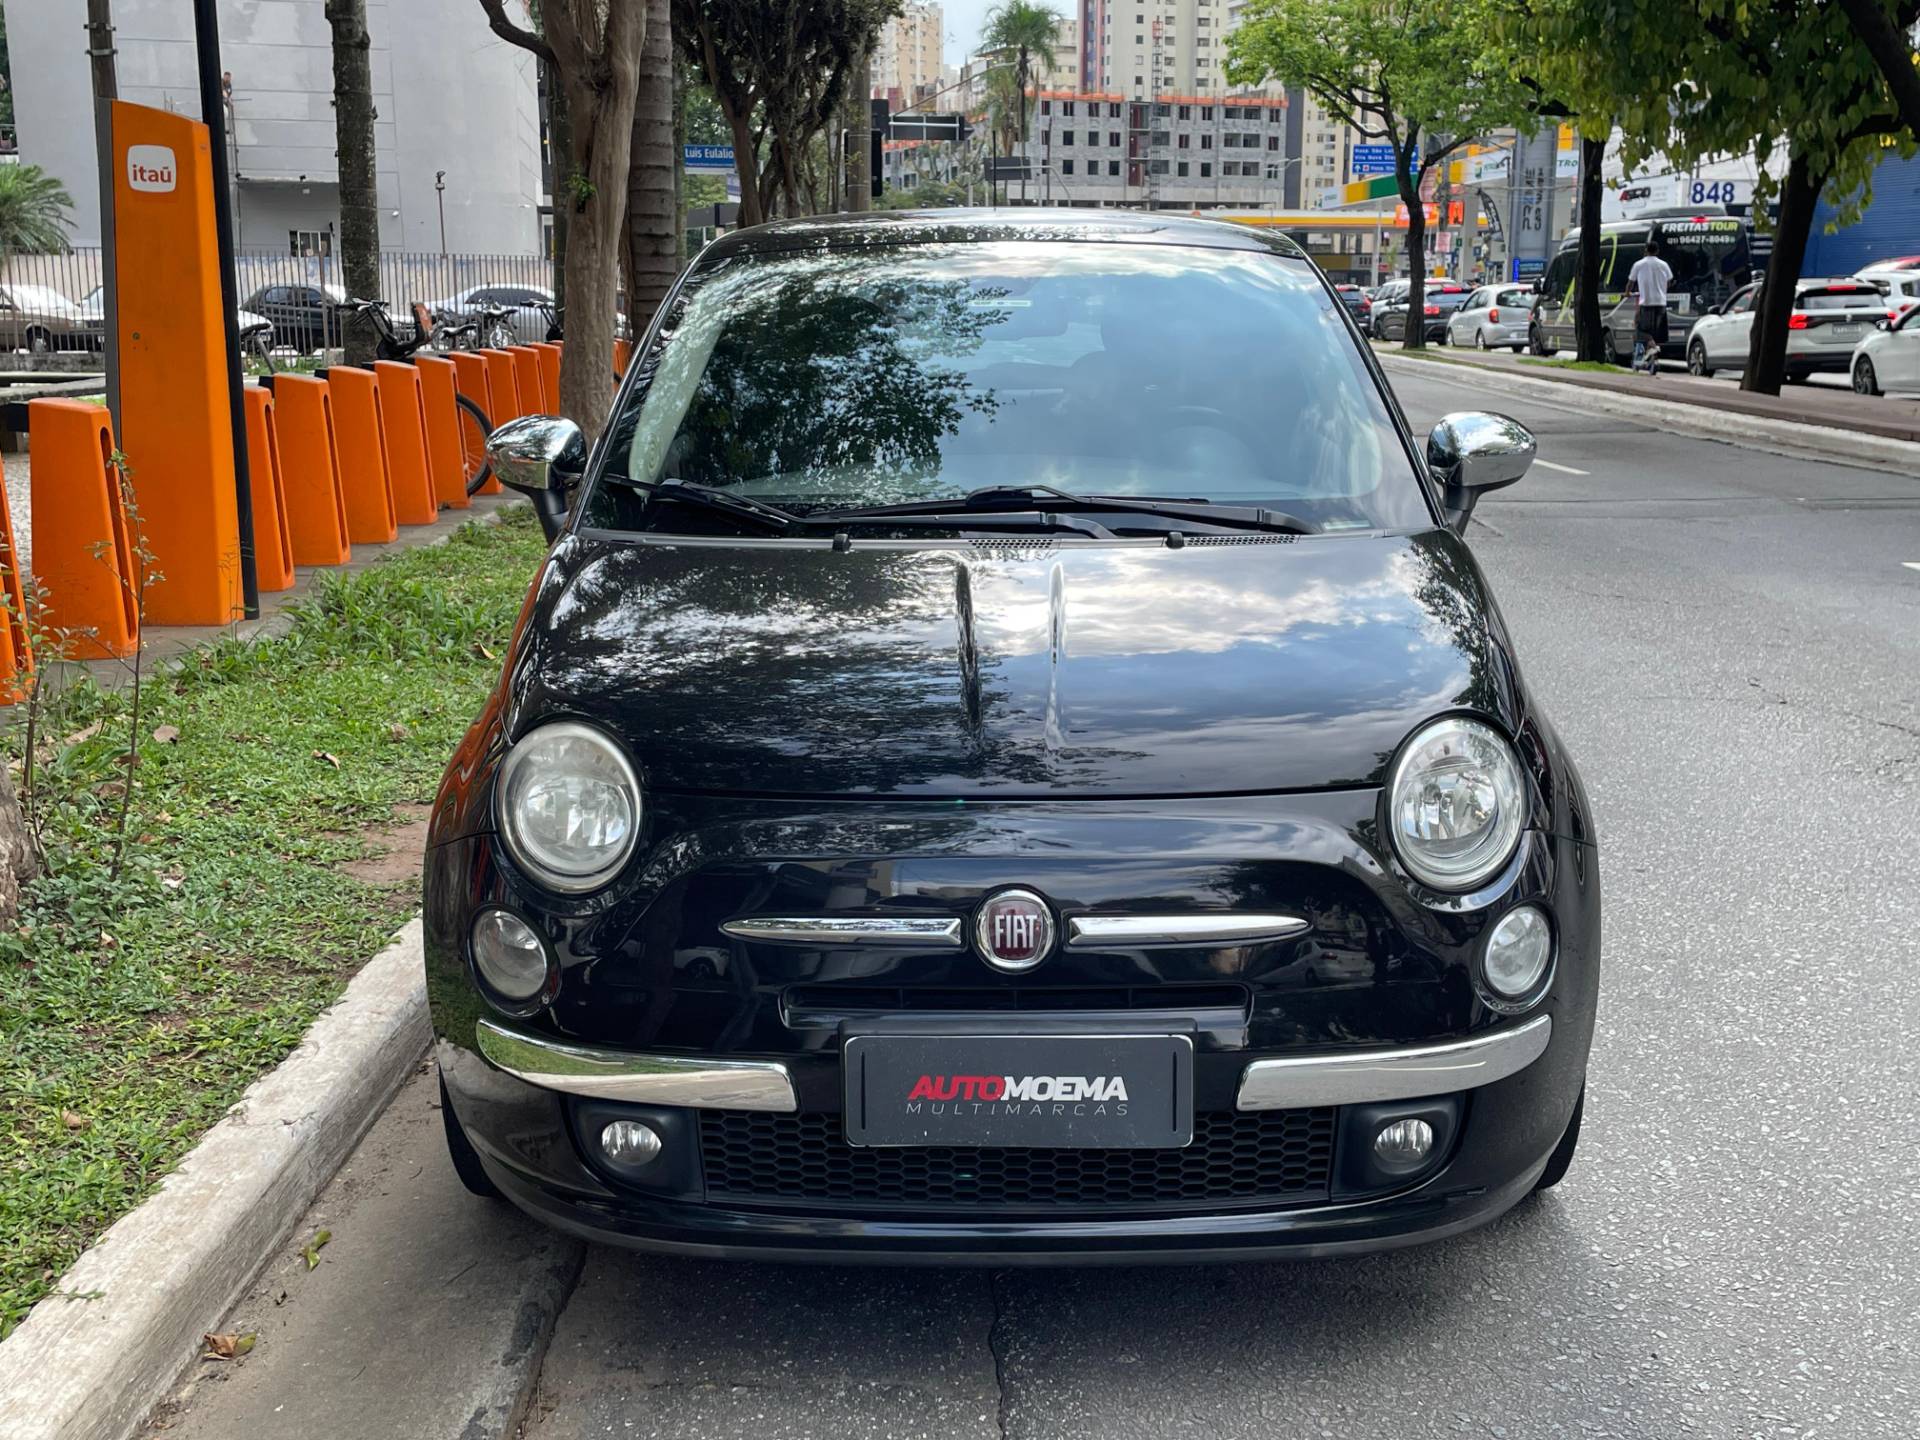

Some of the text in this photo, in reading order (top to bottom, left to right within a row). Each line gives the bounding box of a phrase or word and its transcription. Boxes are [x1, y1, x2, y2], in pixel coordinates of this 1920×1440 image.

[132, 163, 172, 183] itaú
[1691, 181, 1735, 204] 848
[995, 914, 1038, 949] FIAT
[905, 1103, 1129, 1116] MULTIMARCAS
